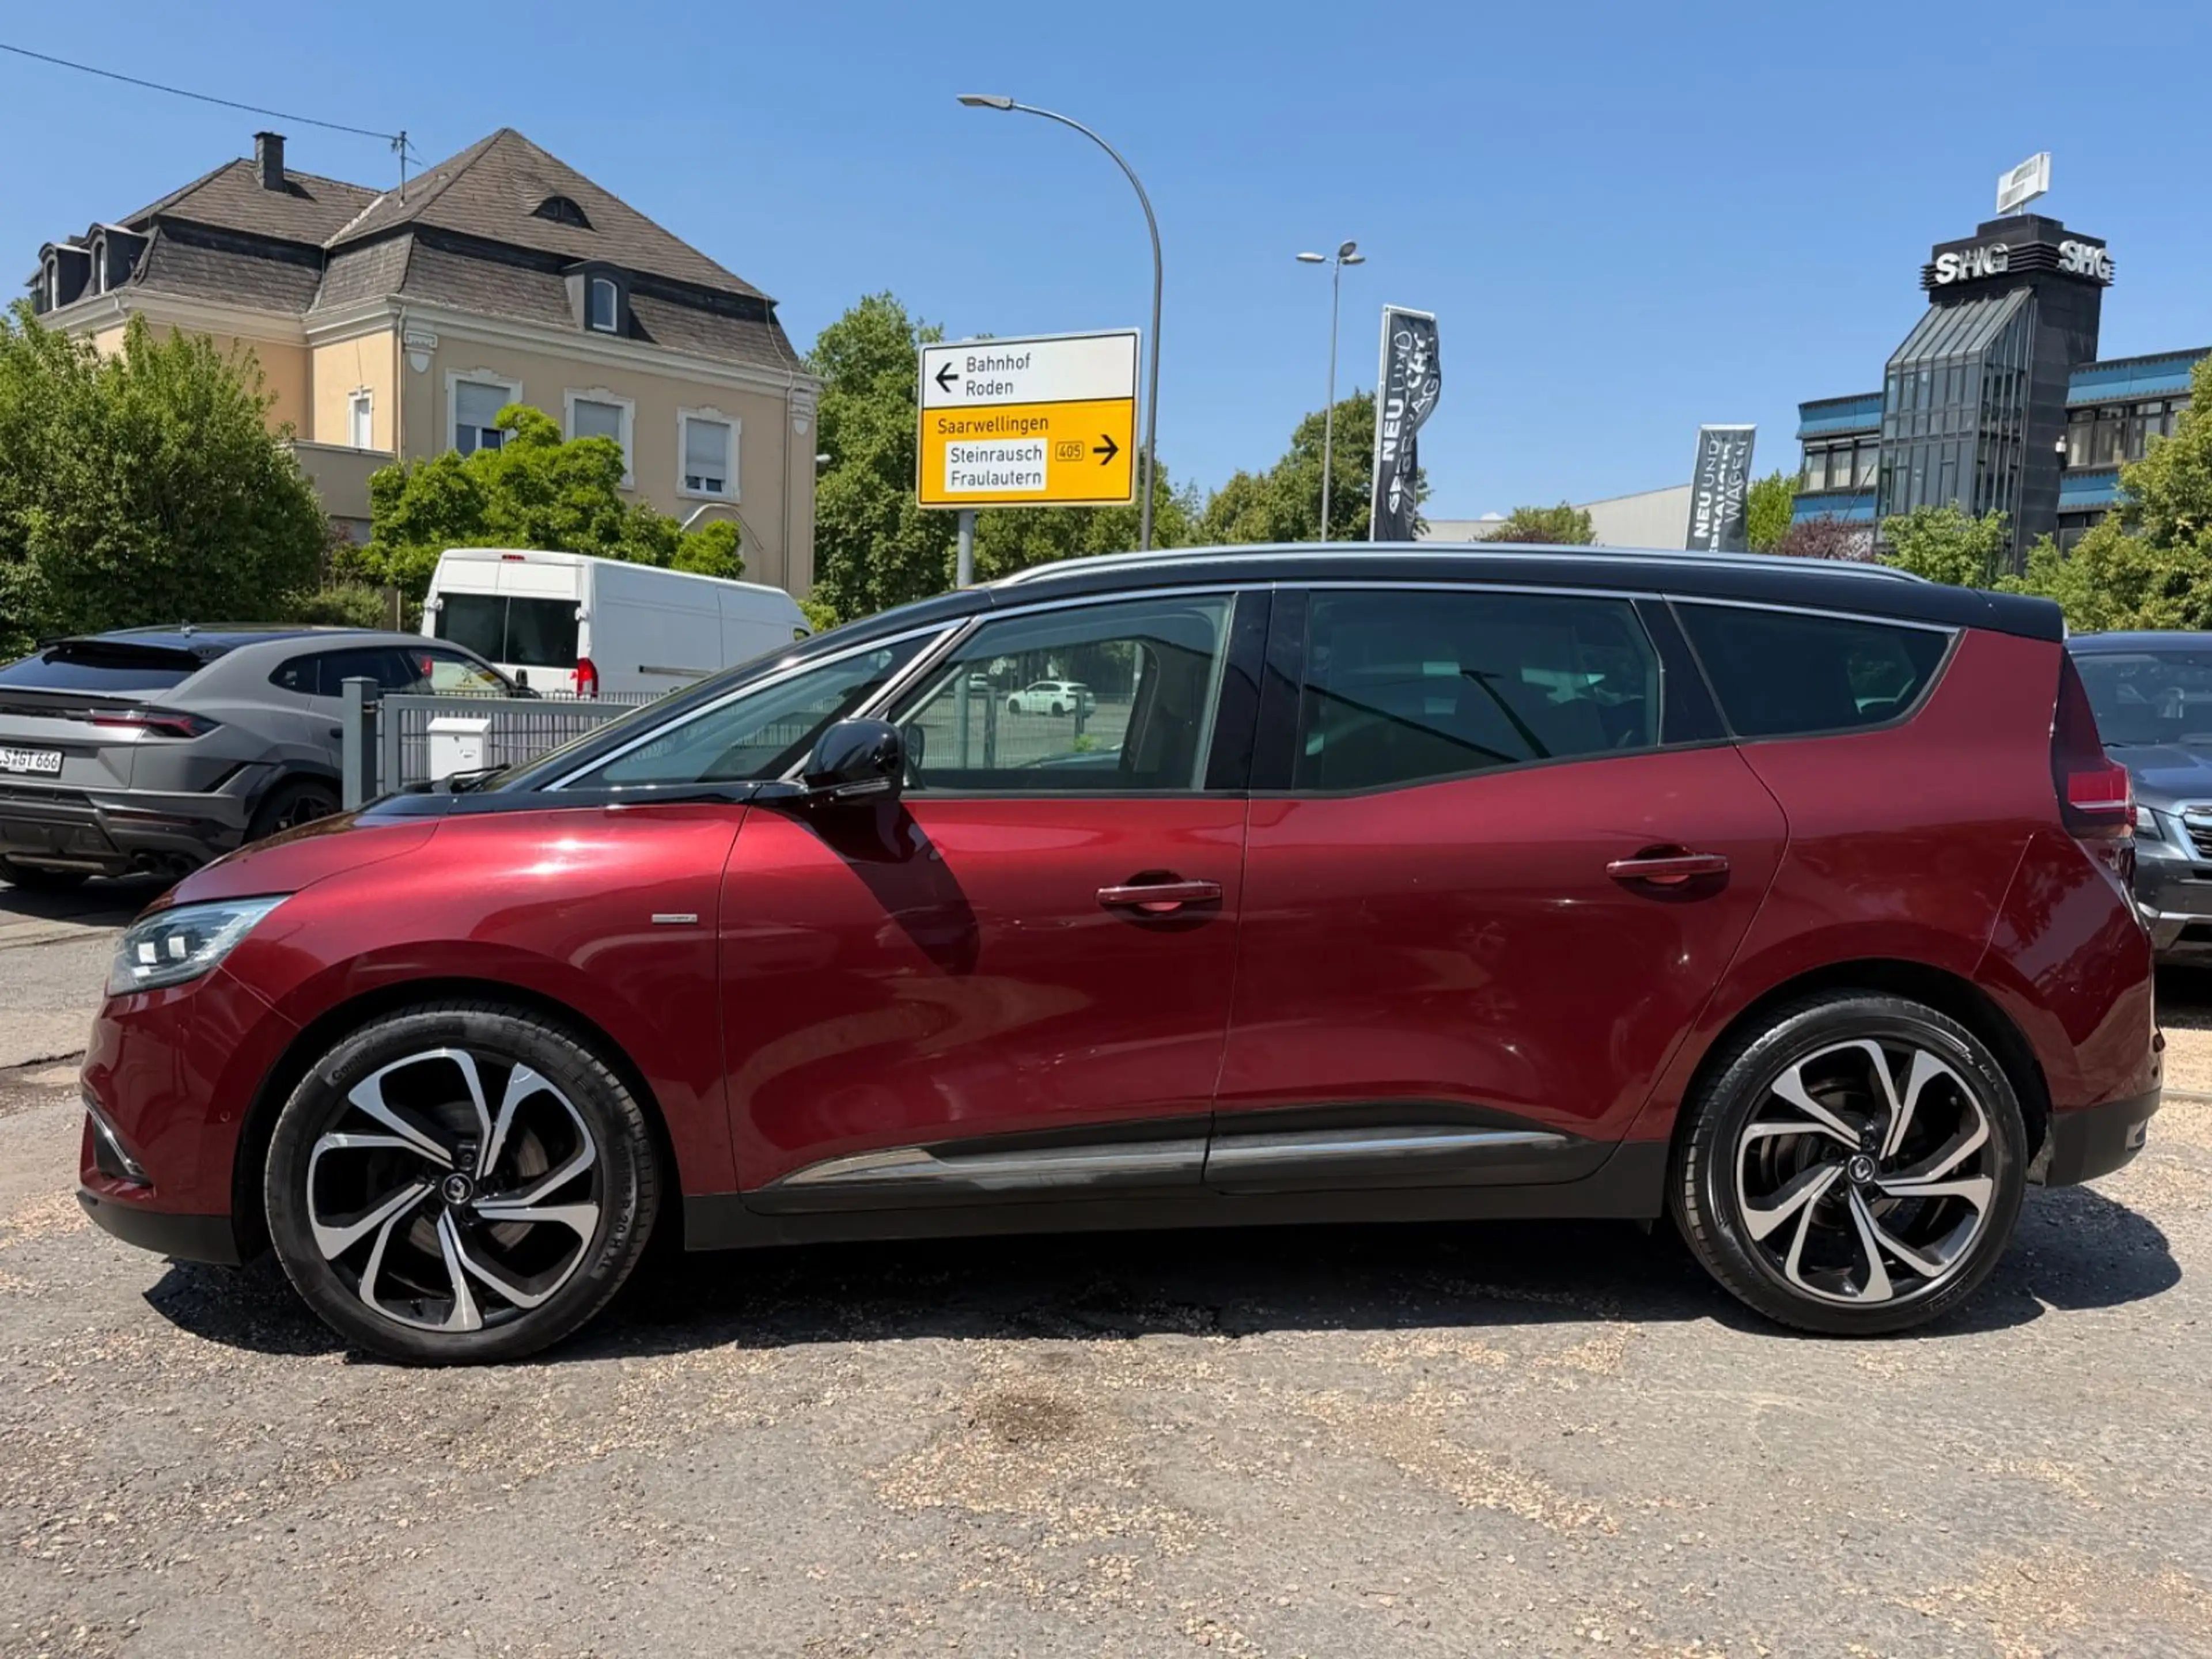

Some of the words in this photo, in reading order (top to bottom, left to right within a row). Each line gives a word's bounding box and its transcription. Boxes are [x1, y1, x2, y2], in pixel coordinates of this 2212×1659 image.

[1935, 243, 2009, 284] SHG
[2058, 240, 2111, 281] SHG
[966, 353, 1031, 373] Bahnhof
[966, 380, 1013, 396] Roden
[938, 415, 1048, 435] Saarwellingen
[1382, 399, 1404, 461] NEU
[950, 445, 1042, 463] Steinrausch
[1059, 444, 1081, 457] 405
[1702, 440, 1719, 488] UND
[951, 469, 1041, 487] Fraulautern
[1694, 491, 1711, 538] NEU
[0, 749, 12, 765] S
[36, 752, 58, 769] 666
